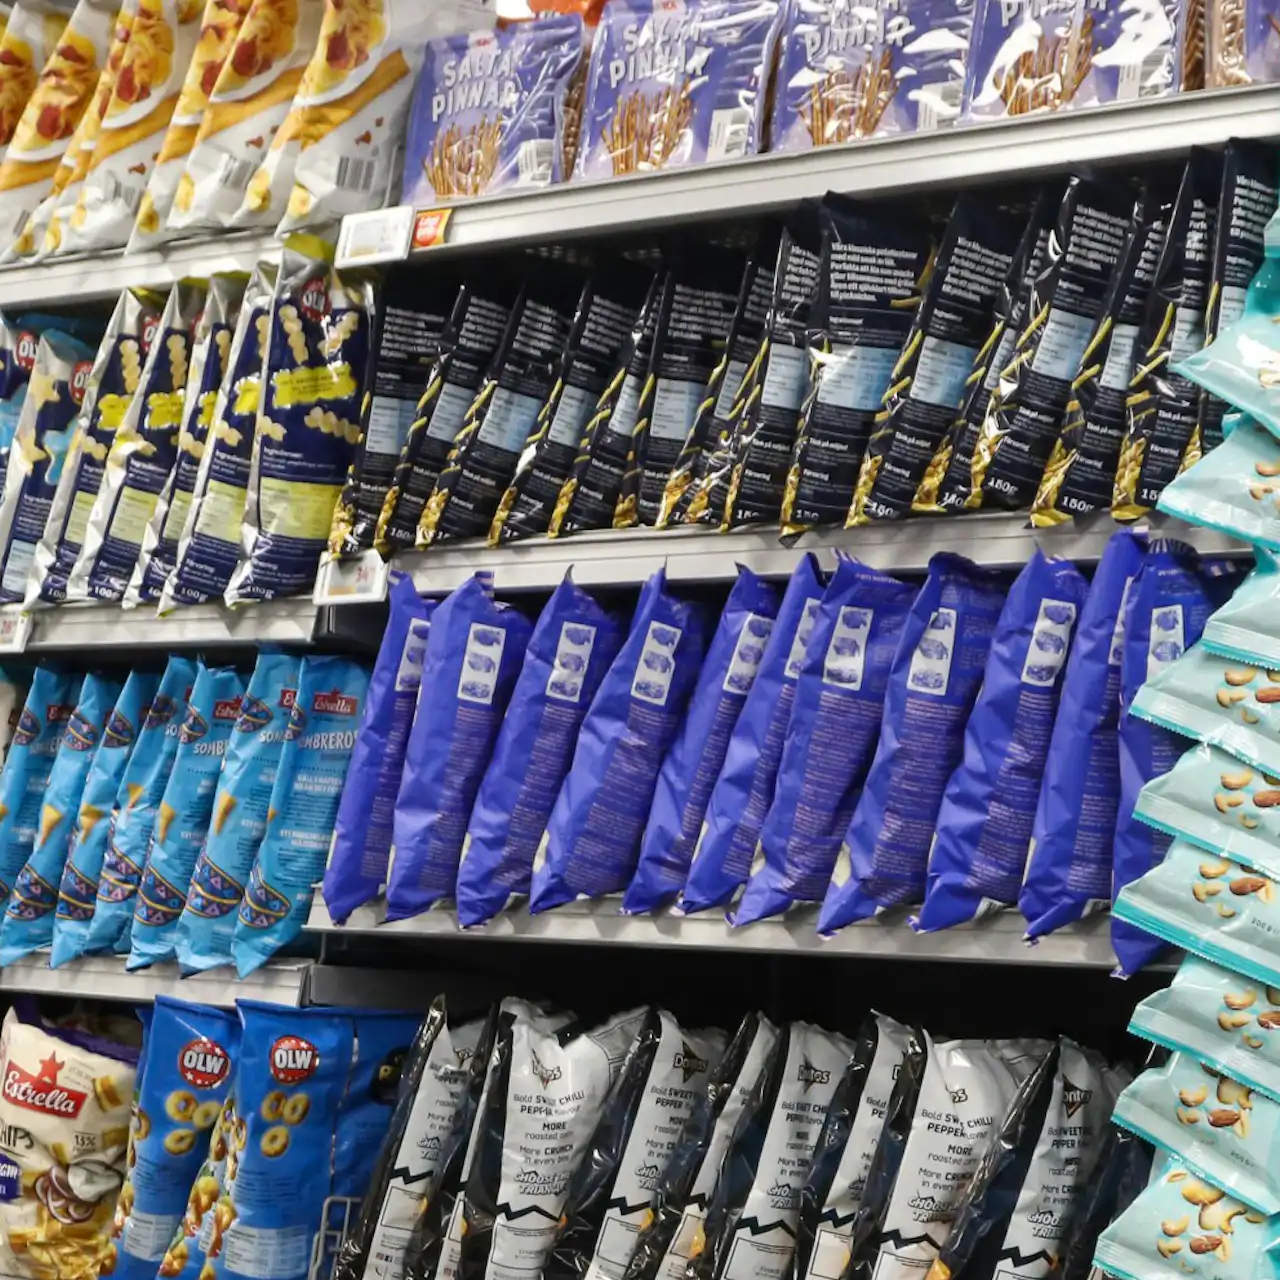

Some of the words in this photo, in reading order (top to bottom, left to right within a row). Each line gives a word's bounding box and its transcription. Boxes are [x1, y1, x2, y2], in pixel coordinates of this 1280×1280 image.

[444, 49, 513, 86] SALTA
[610, 46, 713, 87] PINNAR
[431, 81, 519, 121] PINNAR
[315, 693, 351, 714] Estrella
[299, 730, 359, 750] OMBRERO
[183, 1051, 225, 1074] OLW
[274, 1049, 312, 1069] OLW
[4, 1070, 76, 1113] Estrella
[513, 1093, 532, 1104] Bold
[656, 1098, 683, 1109] PEPPER
[921, 1109, 941, 1120] Bold
[542, 1122, 567, 1131] MORE
[520, 1145, 540, 1155] More
[948, 1144, 973, 1156] MORE
[919, 1167, 941, 1179] More
[1042, 1184, 1059, 1193] More
[1027, 1212, 1059, 1227] CHOO
